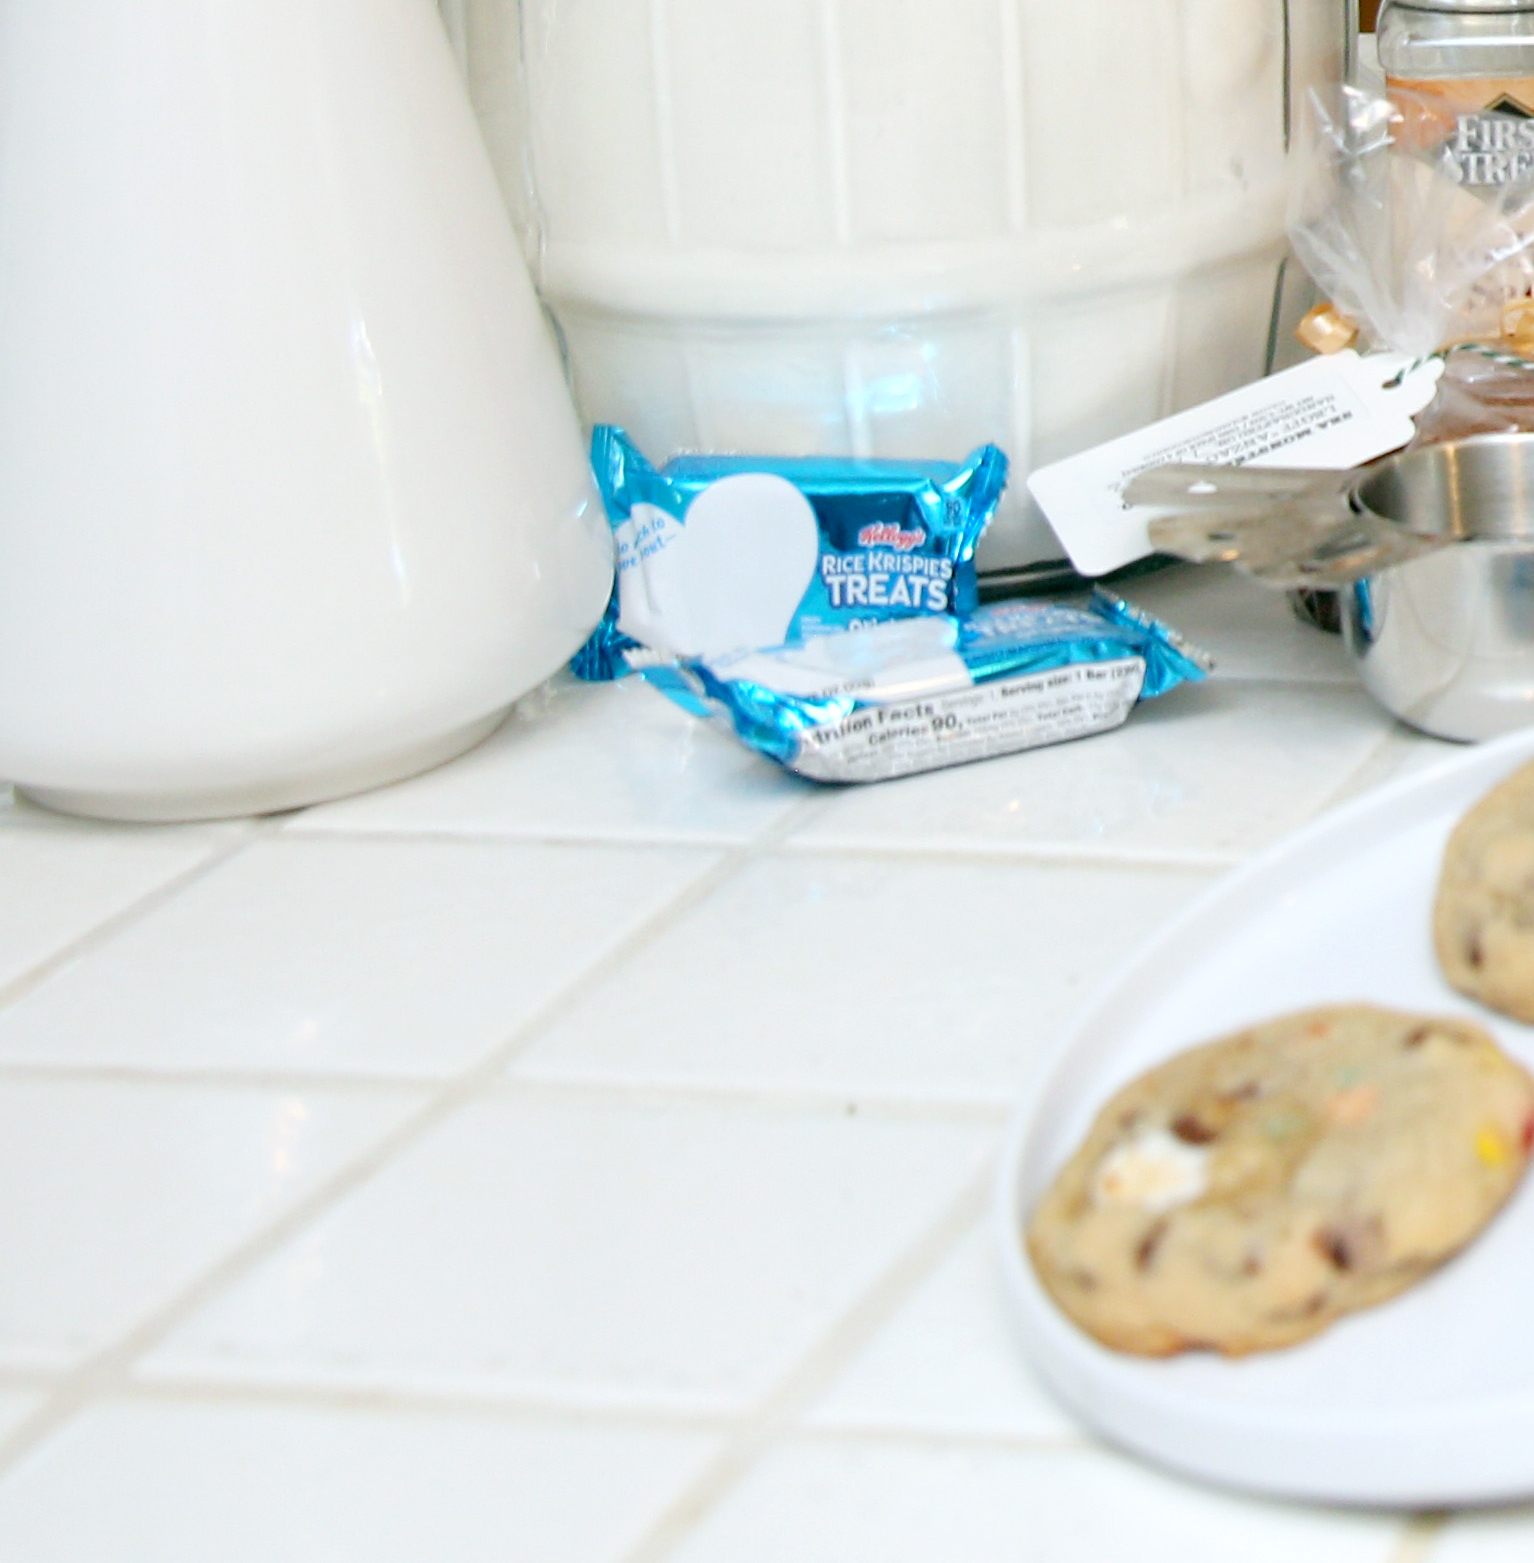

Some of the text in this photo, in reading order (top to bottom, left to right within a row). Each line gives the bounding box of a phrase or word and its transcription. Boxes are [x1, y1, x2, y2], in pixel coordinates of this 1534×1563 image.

[822, 551, 952, 580] RICE KRISPIES
[826, 574, 948, 612] TREATS
